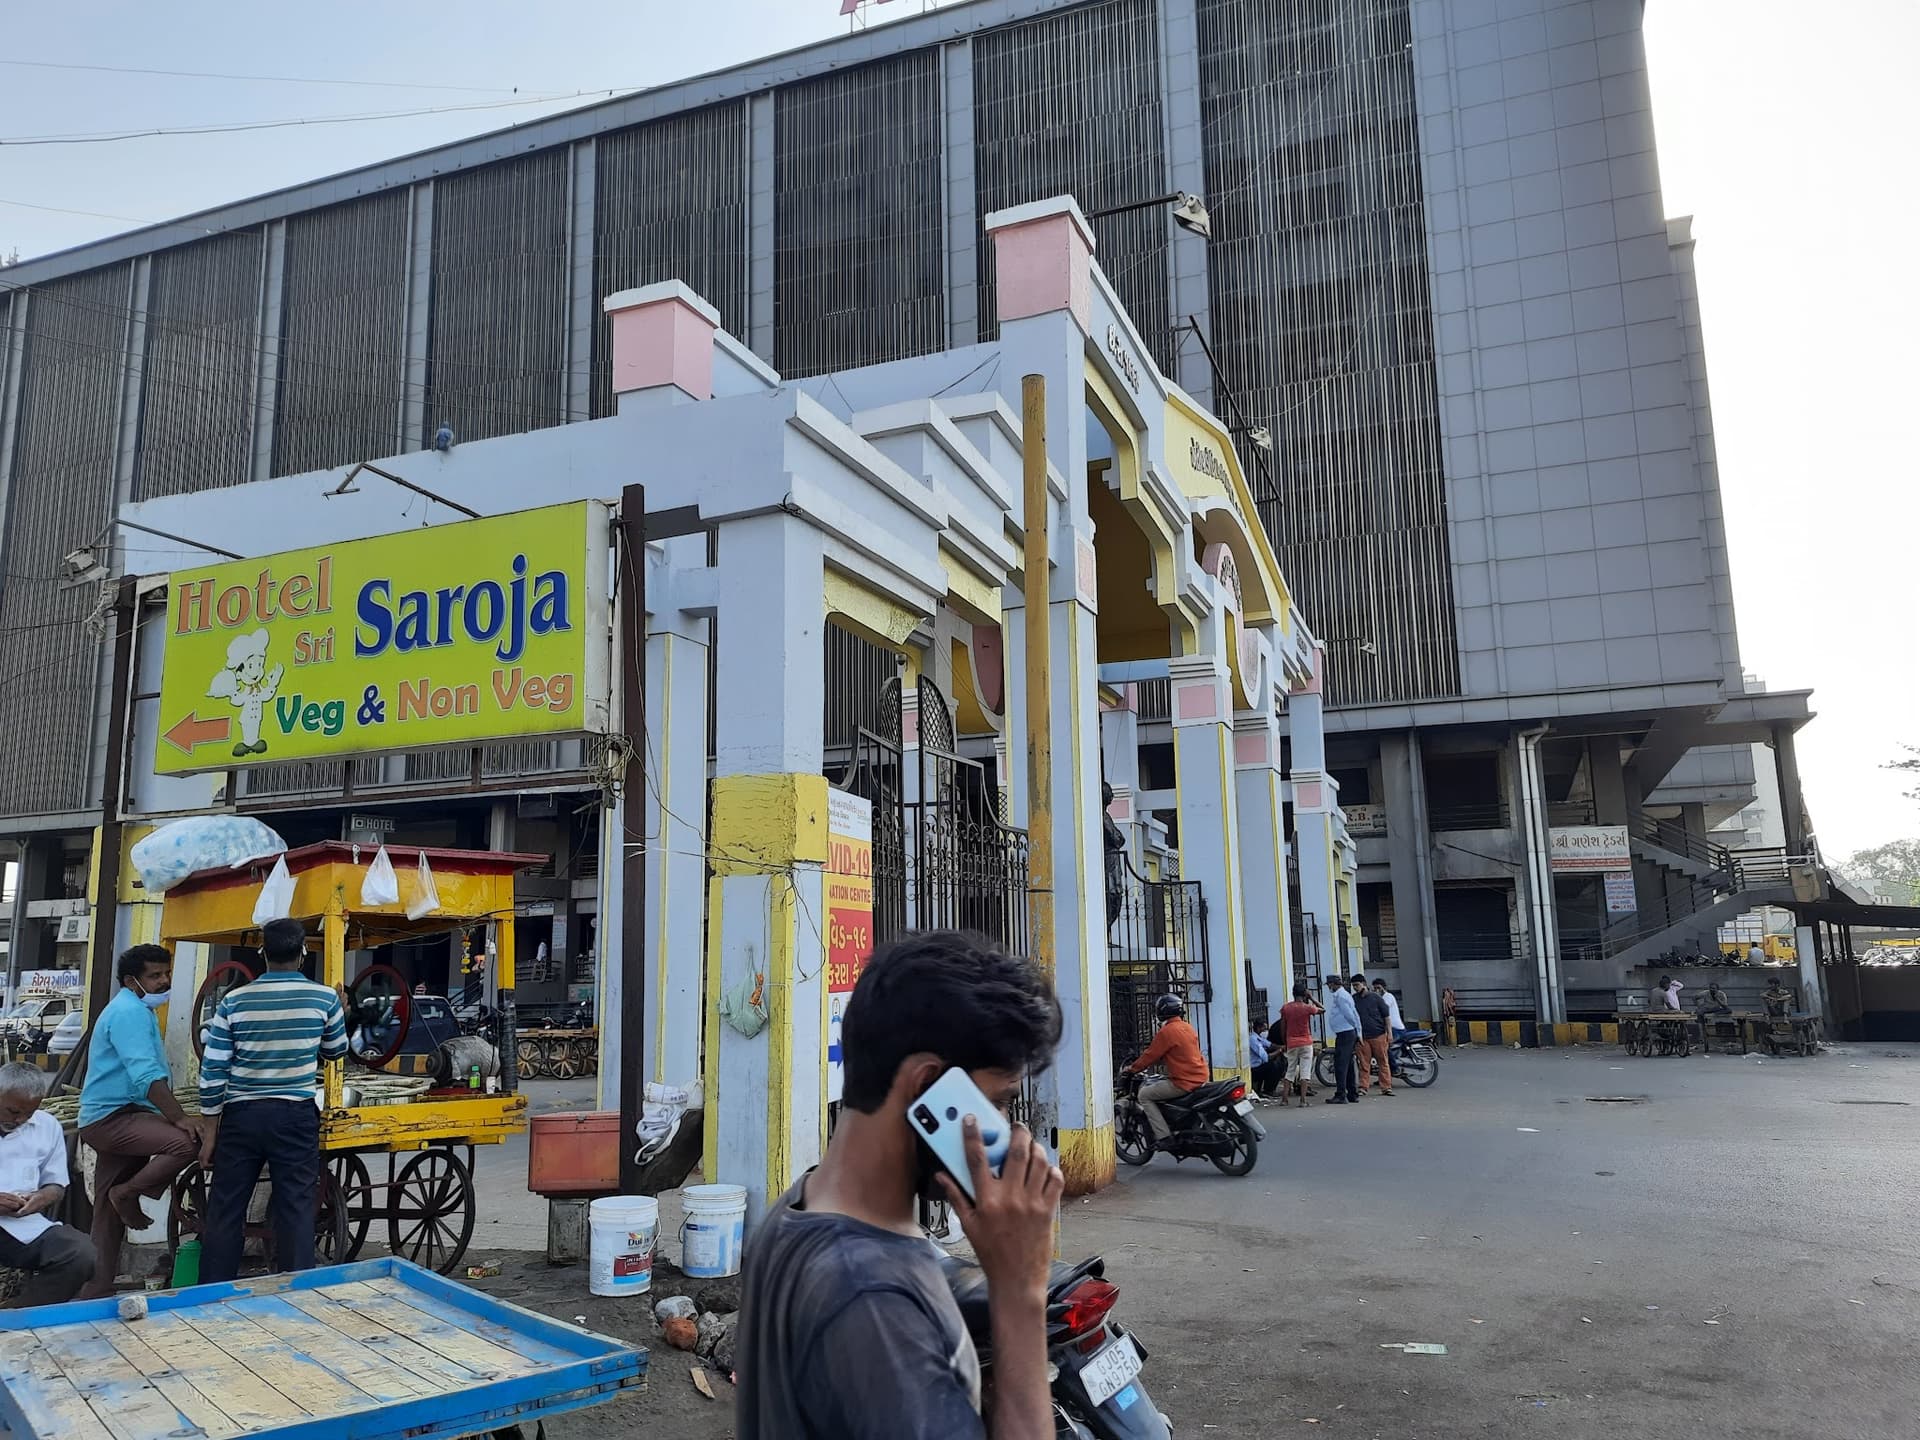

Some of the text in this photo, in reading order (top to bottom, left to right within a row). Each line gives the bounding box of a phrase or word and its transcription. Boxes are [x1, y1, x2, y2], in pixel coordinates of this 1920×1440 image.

[174, 556, 333, 635] Hotel
[294, 553, 572, 666] Sri Saroja
[276, 667, 574, 736] Veg & Non Veg
[366, 818, 396, 831] HOTEL
[1571, 834, 1600, 849] ગણેશ
[850, 887, 871, 903] CENTRE
[1096, 1344, 1126, 1376] GJ05
[1098, 1356, 1139, 1397] GN9750
